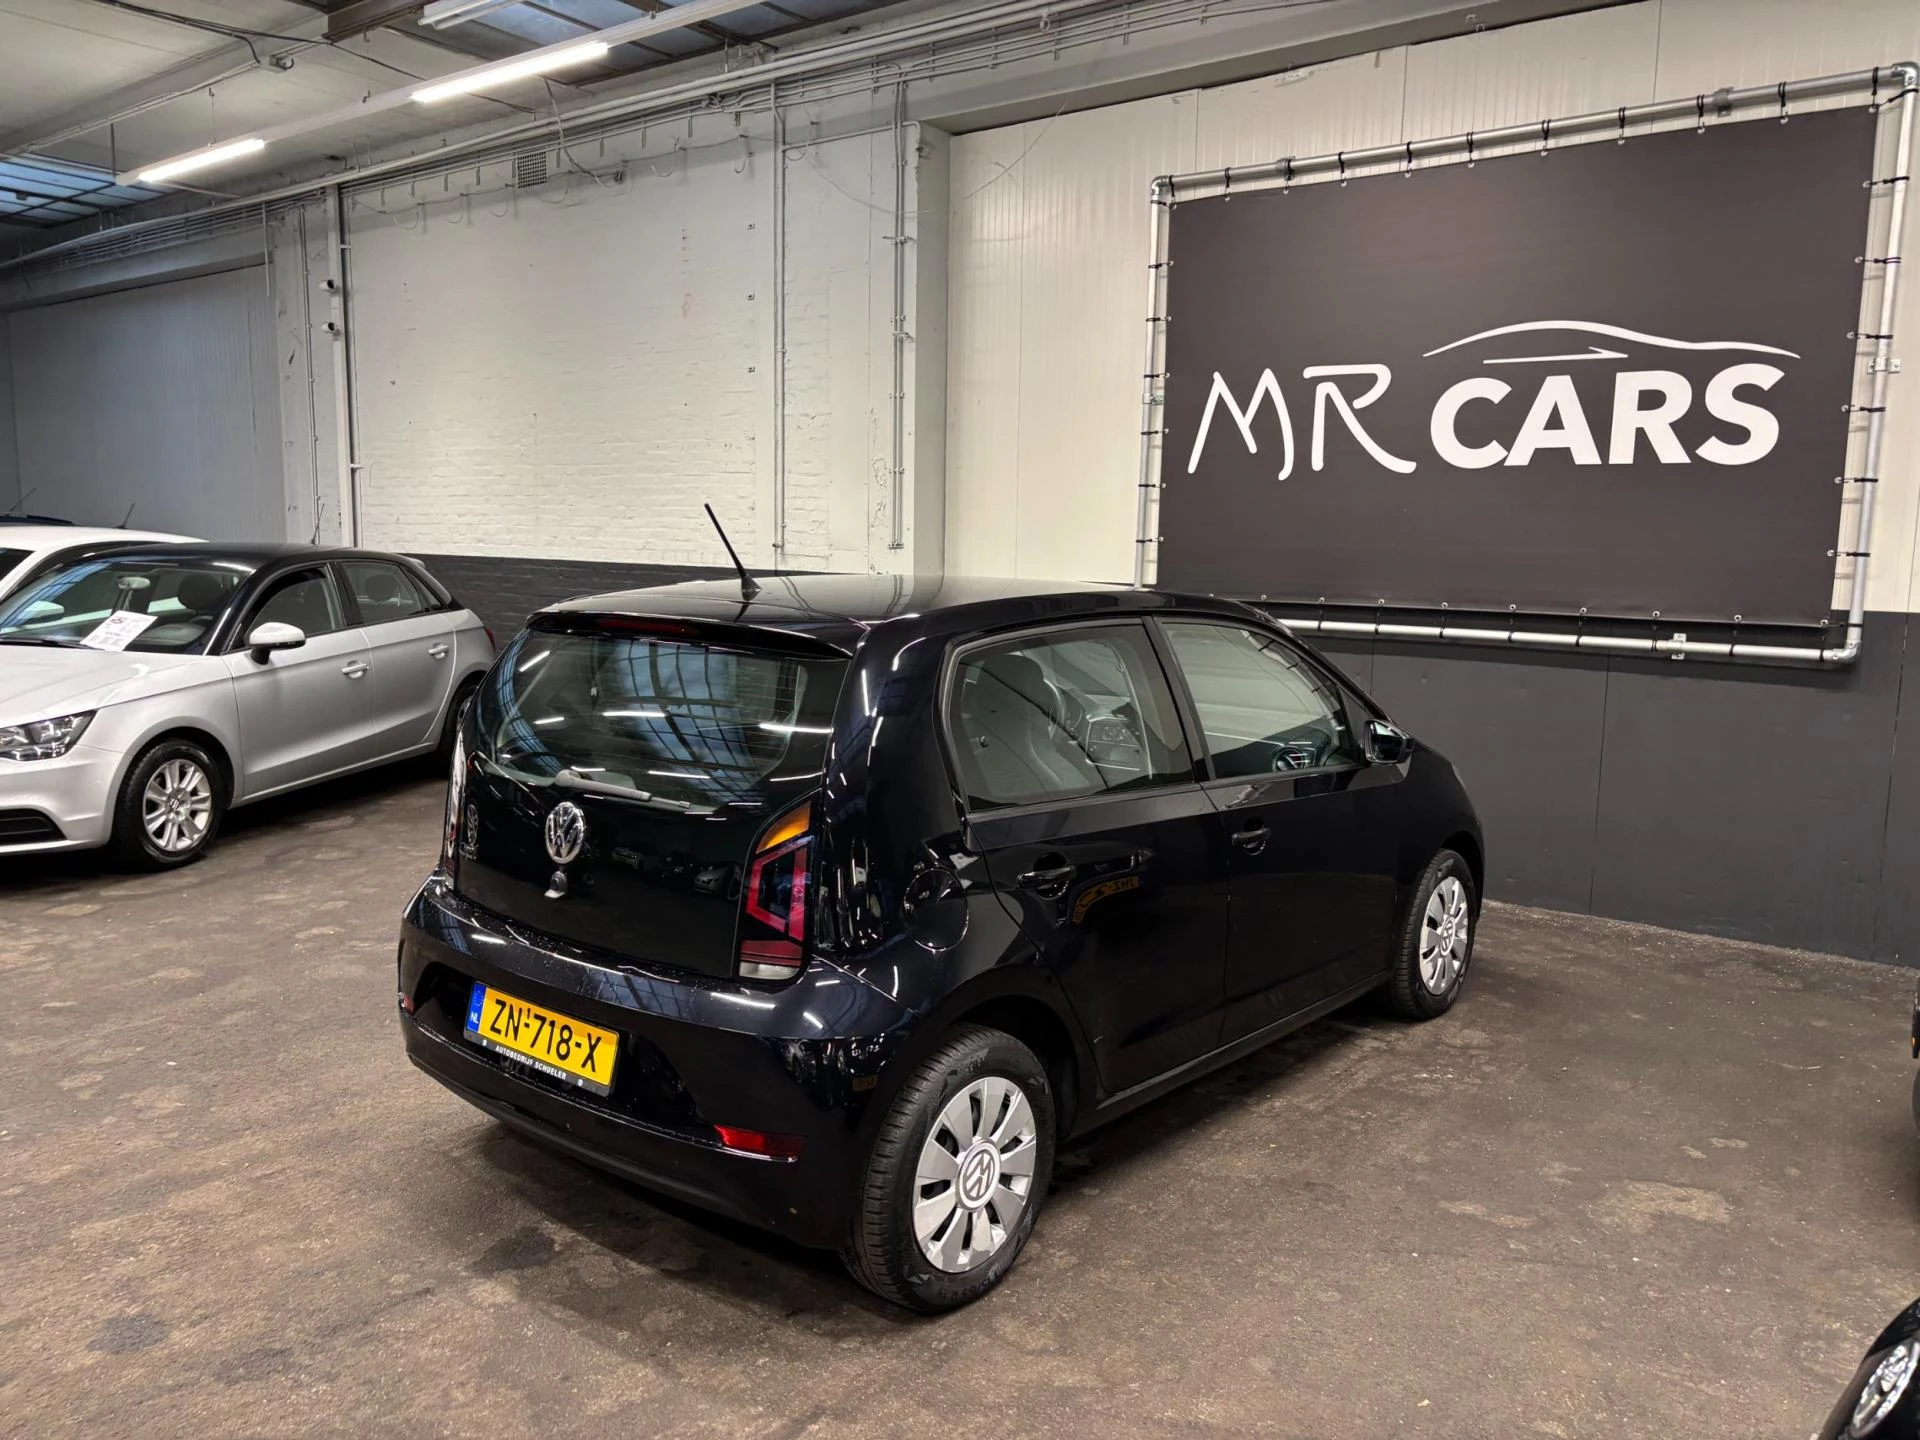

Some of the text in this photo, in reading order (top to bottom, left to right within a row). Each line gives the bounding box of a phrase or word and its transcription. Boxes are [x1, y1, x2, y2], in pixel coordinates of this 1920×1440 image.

[1187, 363, 1785, 481] MR CARS
[470, 1011, 479, 1024] NL
[489, 998, 603, 1073] ZN-718-X
[495, 1045, 534, 1066] AUTOBEDRIJF
